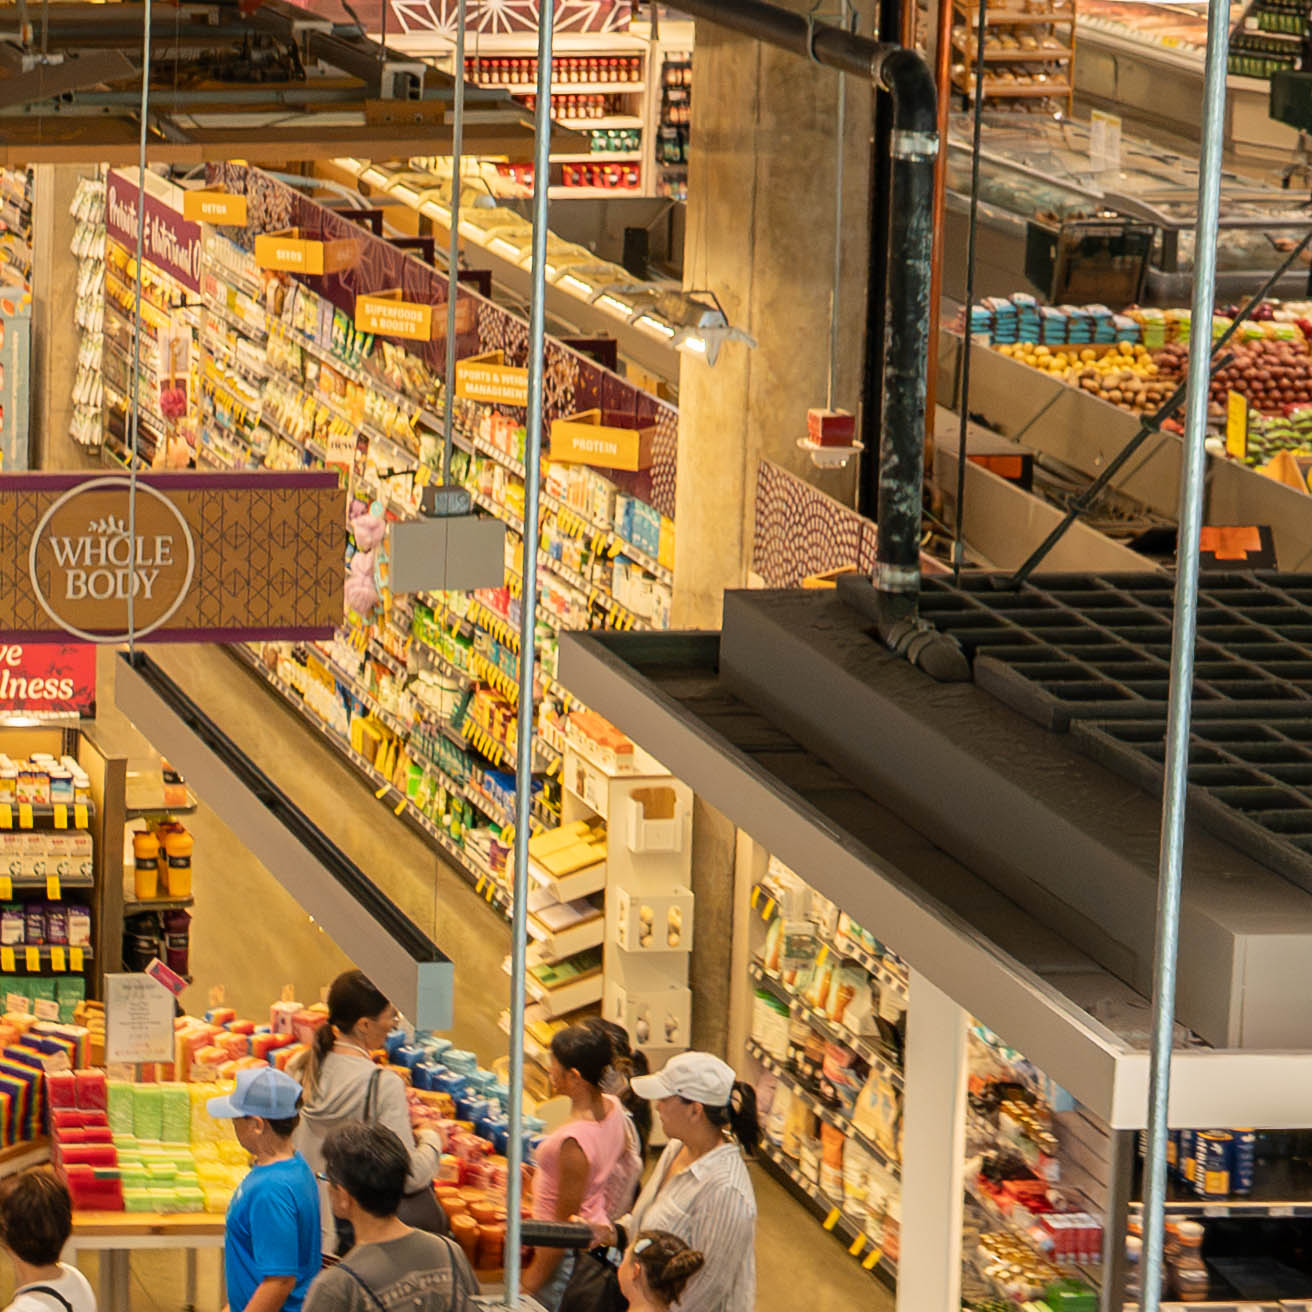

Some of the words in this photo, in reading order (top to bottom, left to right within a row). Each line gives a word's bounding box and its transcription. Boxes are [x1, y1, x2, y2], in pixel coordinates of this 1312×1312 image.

[364, 303, 423, 322] SUPERFOODS
[379, 318, 416, 334] BOOSTS
[458, 368, 491, 383] SPORTS
[502, 373, 528, 387] WEIG
[572, 437, 618, 456] PROTEIN
[49, 531, 174, 567] WHOLE
[65, 568, 160, 600] BODY
